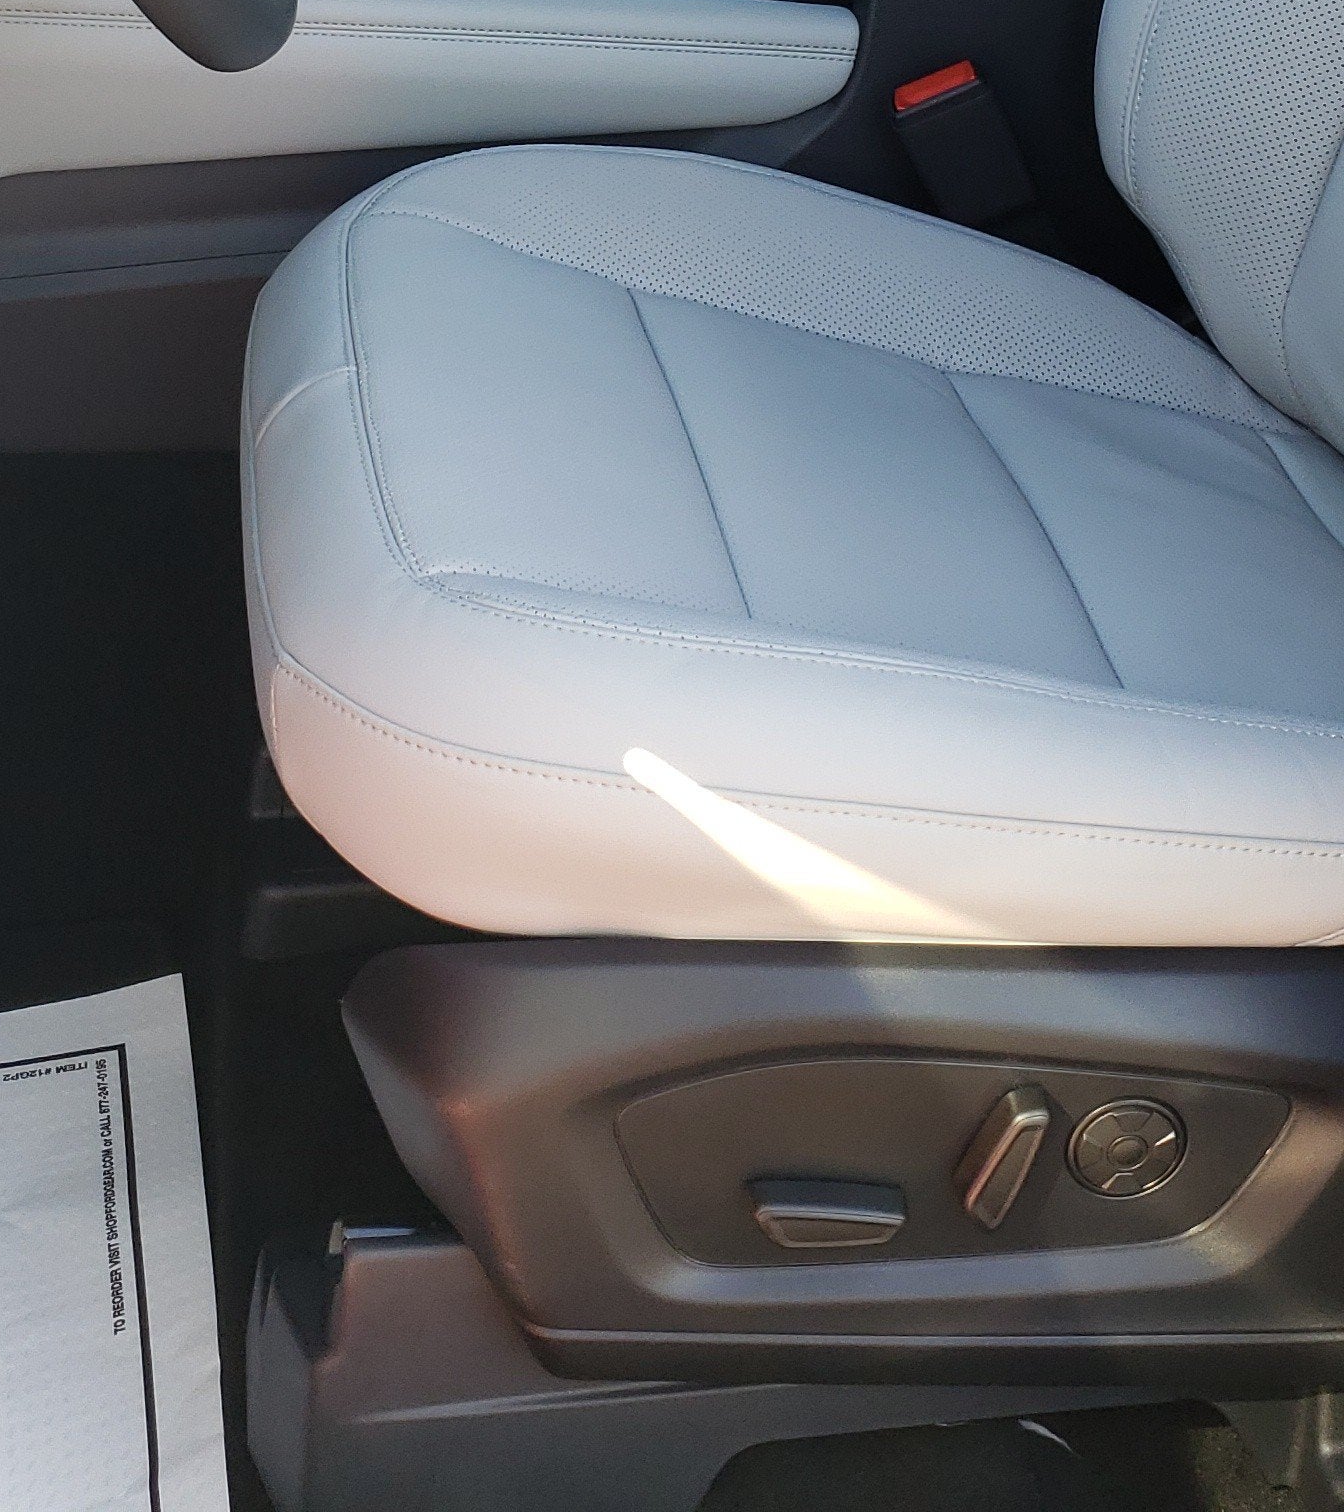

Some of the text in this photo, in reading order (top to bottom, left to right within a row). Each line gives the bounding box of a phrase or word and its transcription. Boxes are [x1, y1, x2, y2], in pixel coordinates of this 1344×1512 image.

[55, 1061, 88, 1074] ITEM
[99, 1115, 112, 1138] CALL
[104, 1139, 112, 1147] or
[108, 1243, 121, 1268] VISIT
[110, 1267, 125, 1320] REORDER
[114, 1318, 126, 1336] TO
